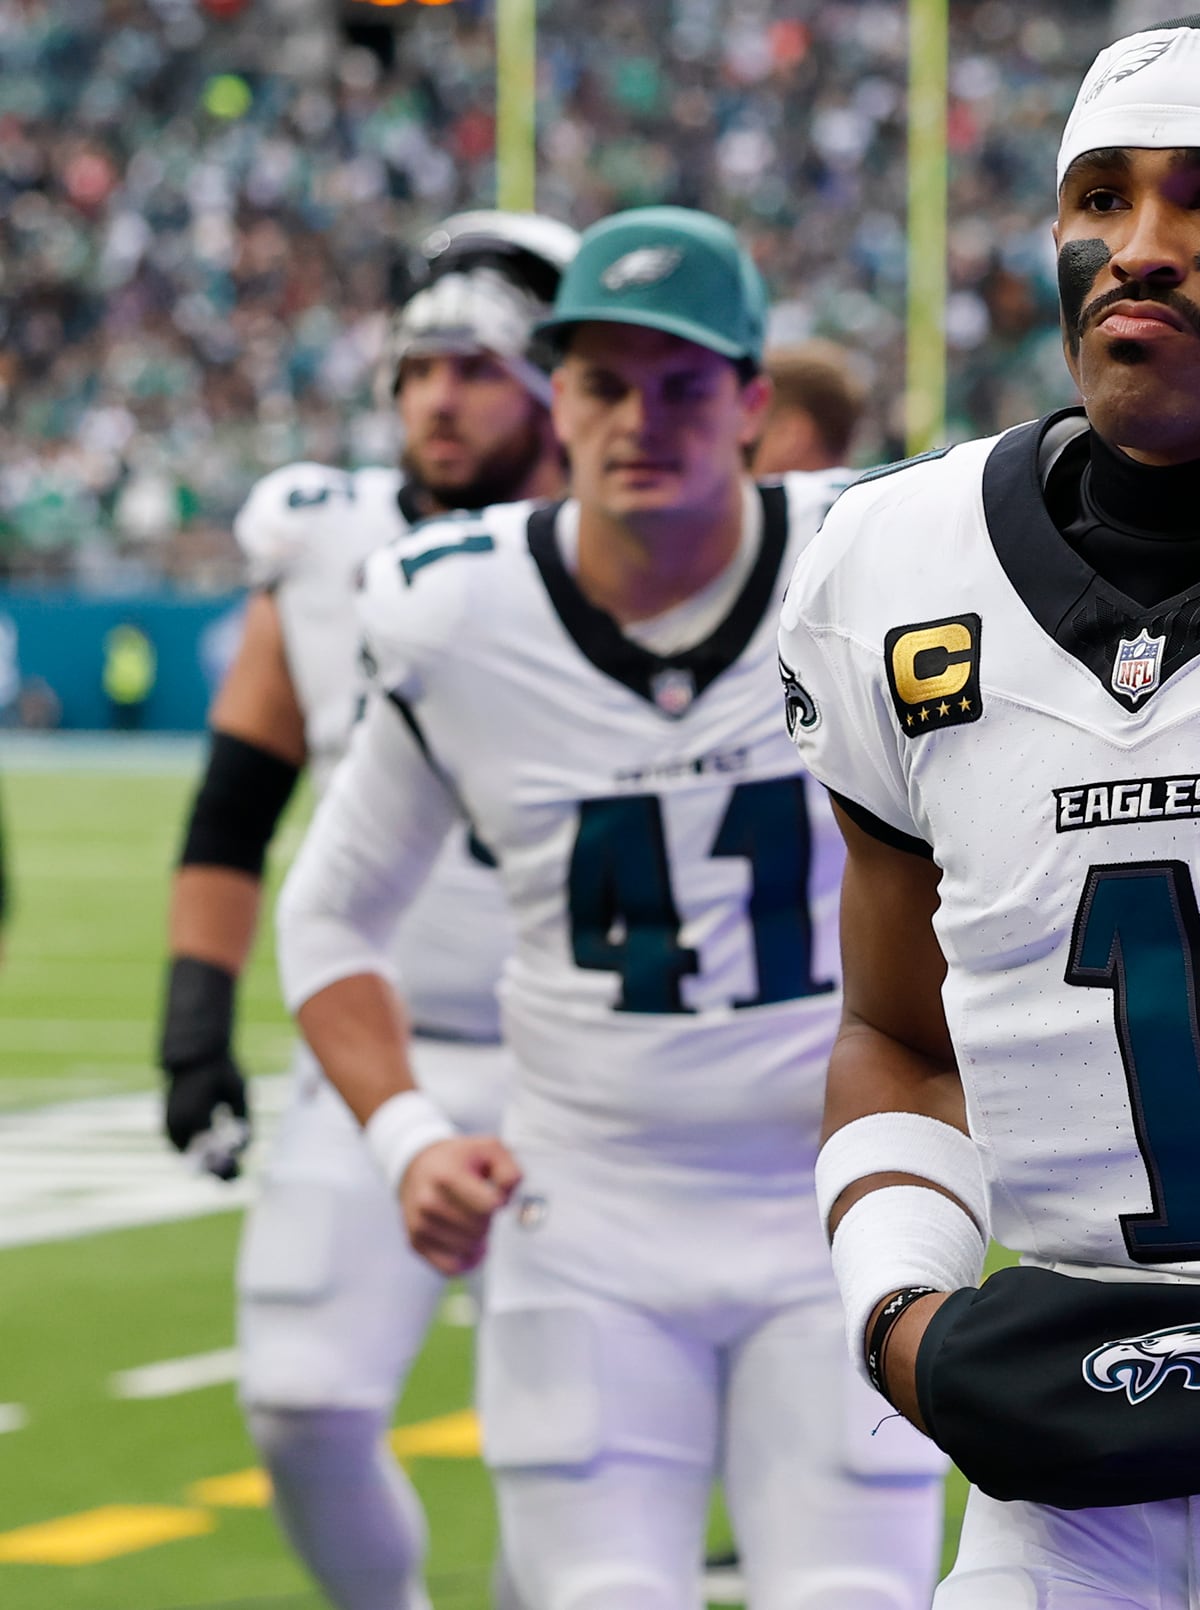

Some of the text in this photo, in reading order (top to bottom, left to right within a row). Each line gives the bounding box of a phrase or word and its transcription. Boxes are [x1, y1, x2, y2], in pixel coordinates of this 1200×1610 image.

[892, 623, 971, 705] C
[1119, 660, 1152, 689] NFL
[565, 775, 836, 1013] 41
